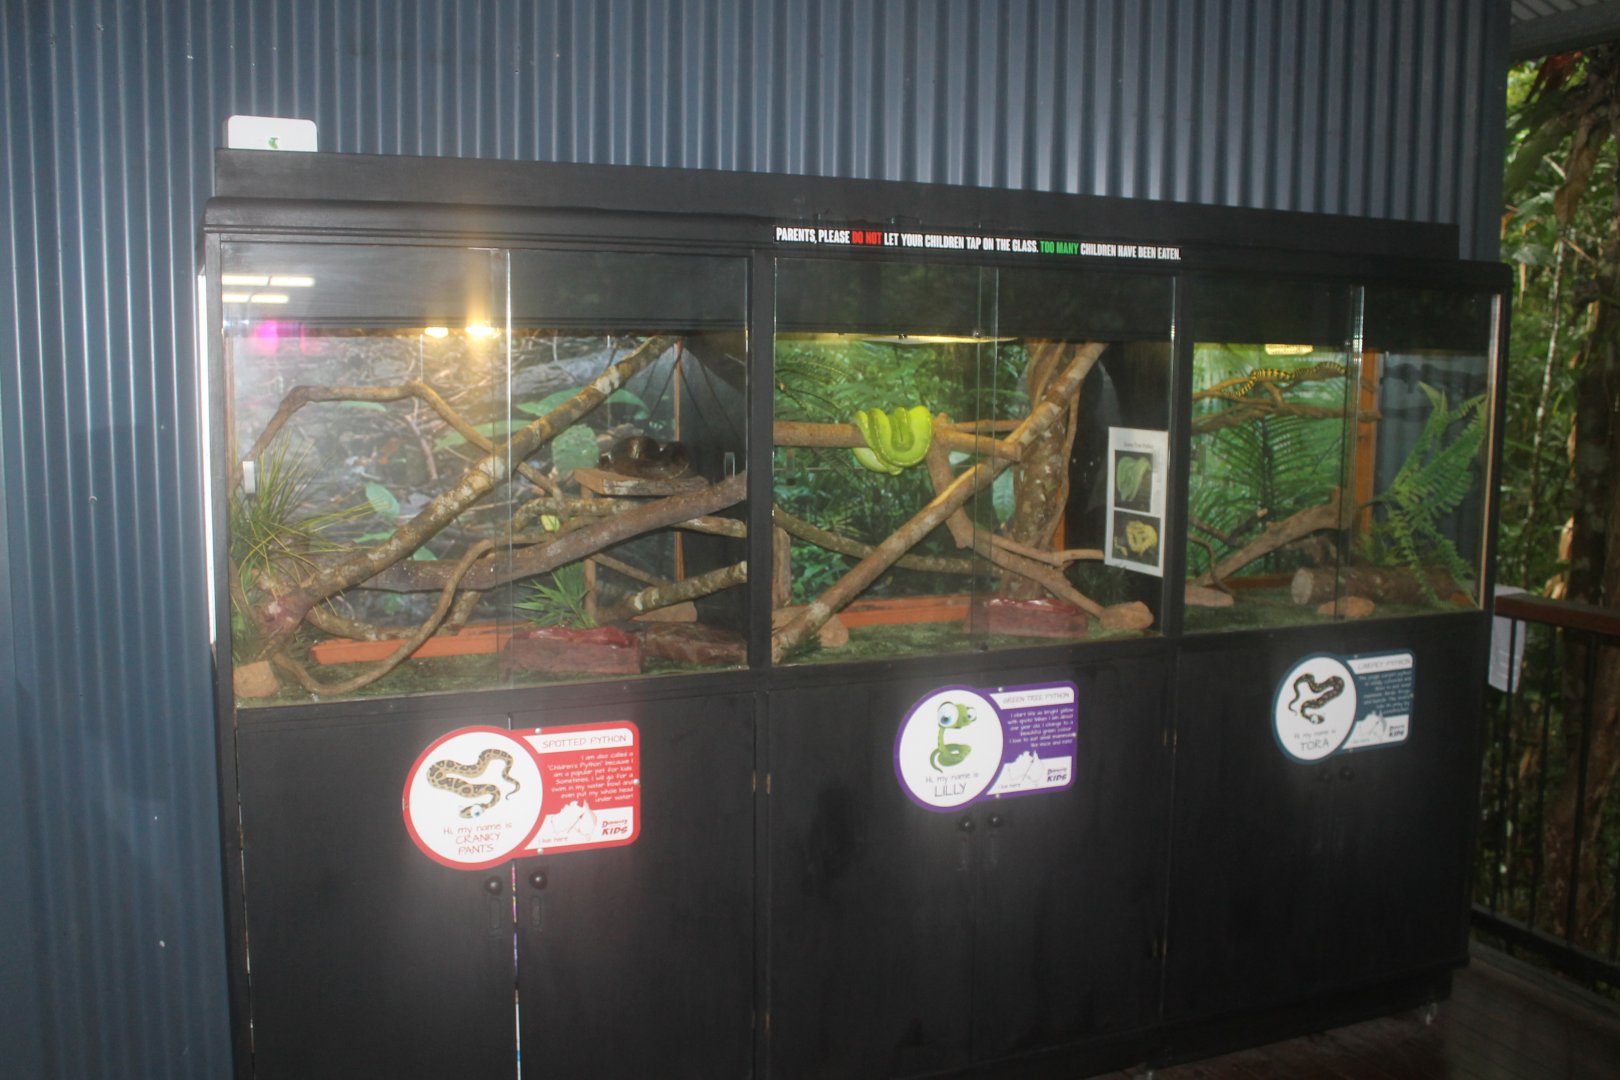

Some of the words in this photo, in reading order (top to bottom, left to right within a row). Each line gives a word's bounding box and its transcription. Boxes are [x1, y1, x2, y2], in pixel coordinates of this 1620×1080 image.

[776, 227, 817, 244] PARENTS,
[818, 229, 850, 244] PLEASE
[852, 231, 864, 244] DO
[866, 232, 882, 244] NOT
[884, 233, 899, 246] LET
[900, 233, 923, 247] YOUR
[925, 234, 964, 248] CHILDREN
[966, 236, 982, 250] TAP
[983, 238, 994, 250] ON
[996, 238, 1010, 251] THE
[1012, 239, 1038, 252] GLASS.
[1040, 240, 1054, 254] TOO
[1056, 241, 1079, 255] MANY
[1080, 242, 1116, 257] CHILDREN
[1118, 244, 1136, 258] HAVE
[1138, 245, 1156, 259] BEEN
[1158, 246, 1181, 260] EATEN.
[542, 737, 586, 748] SPOTTED
[590, 734, 627, 744] PYTHON
[1300, 738, 1330, 752] TORA
[570, 769, 592, 778] popular
[594, 768, 605, 776] pet
[936, 776, 948, 784] my
[951, 772, 971, 781] name
[934, 783, 967, 798] LILLY
[456, 824, 474, 836] my
[476, 820, 500, 832] name
[602, 826, 628, 836] KIDS
[456, 832, 502, 846] CRANKY
[458, 844, 494, 856] PANTS
